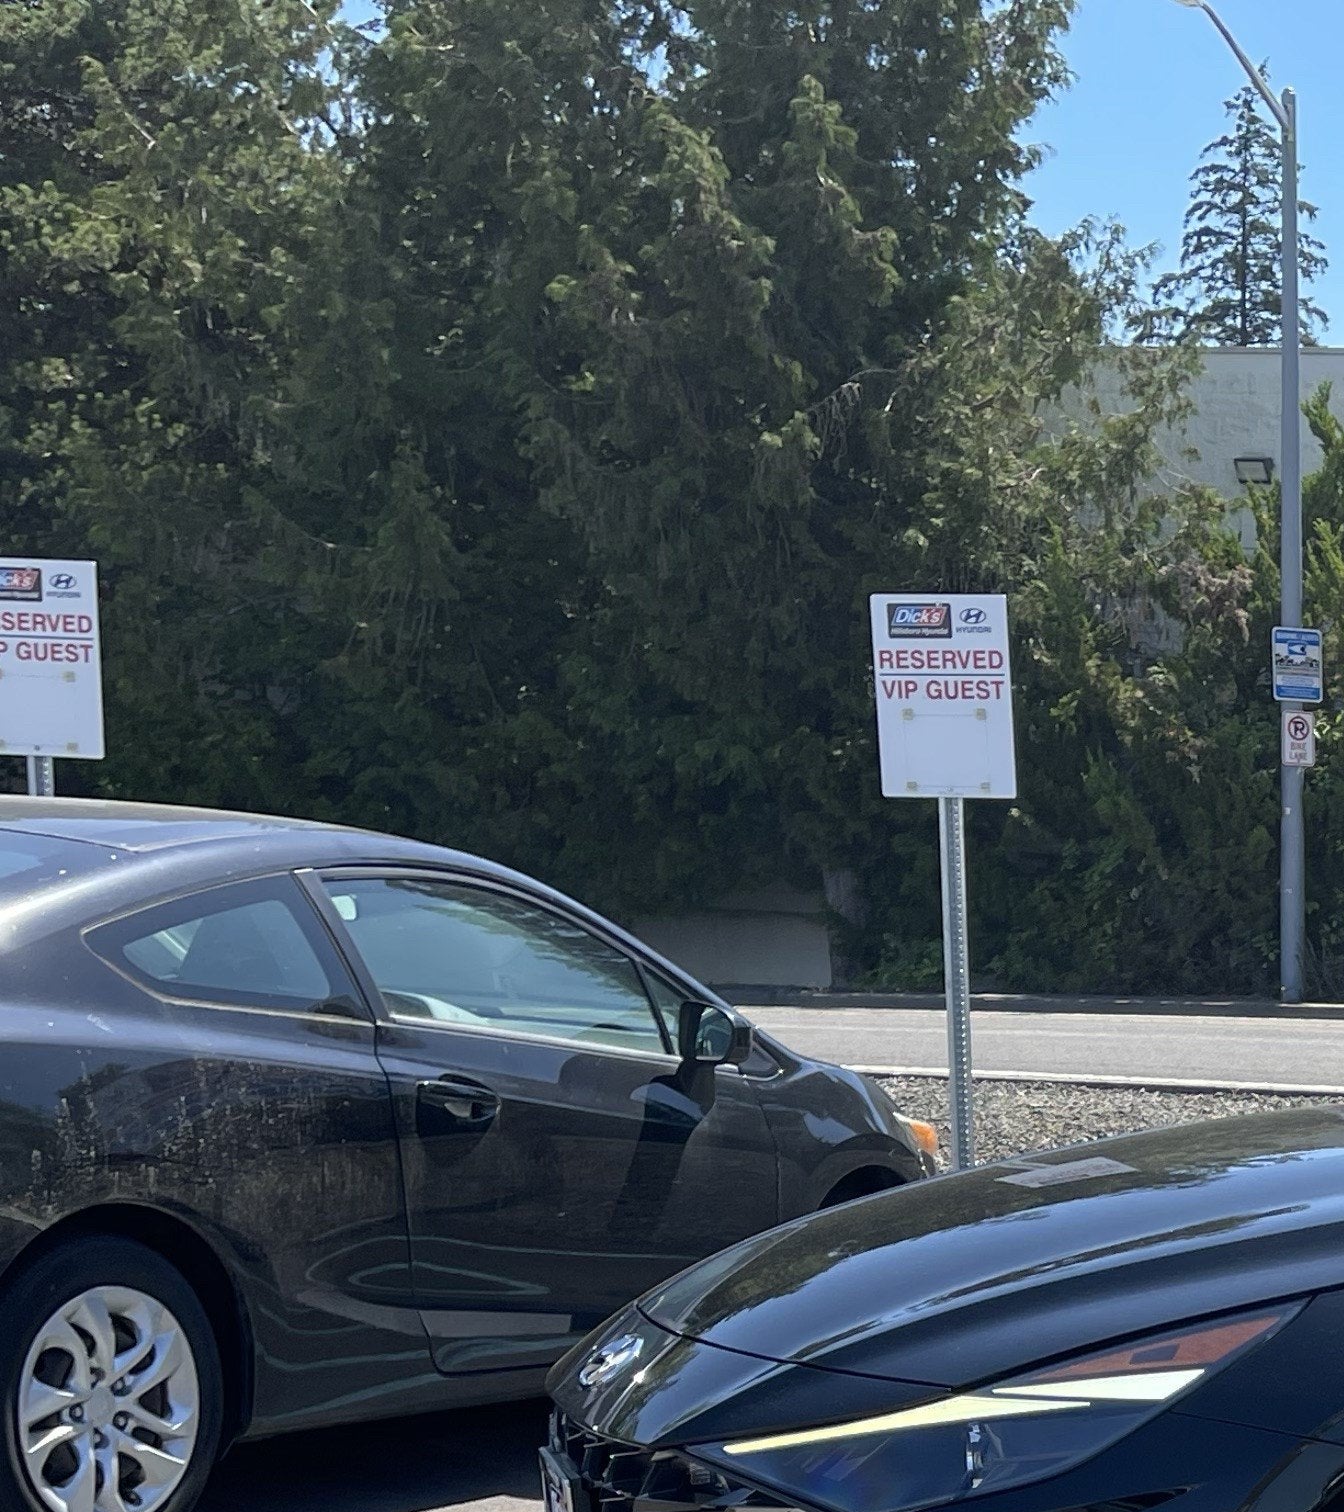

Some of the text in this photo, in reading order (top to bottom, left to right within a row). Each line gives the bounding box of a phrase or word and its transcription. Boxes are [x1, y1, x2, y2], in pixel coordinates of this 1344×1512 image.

[0, 612, 93, 633] SERVED
[15, 641, 94, 663] GUEST
[879, 649, 1004, 670] RESERVED
[882, 680, 1005, 700] VIP GUEST
